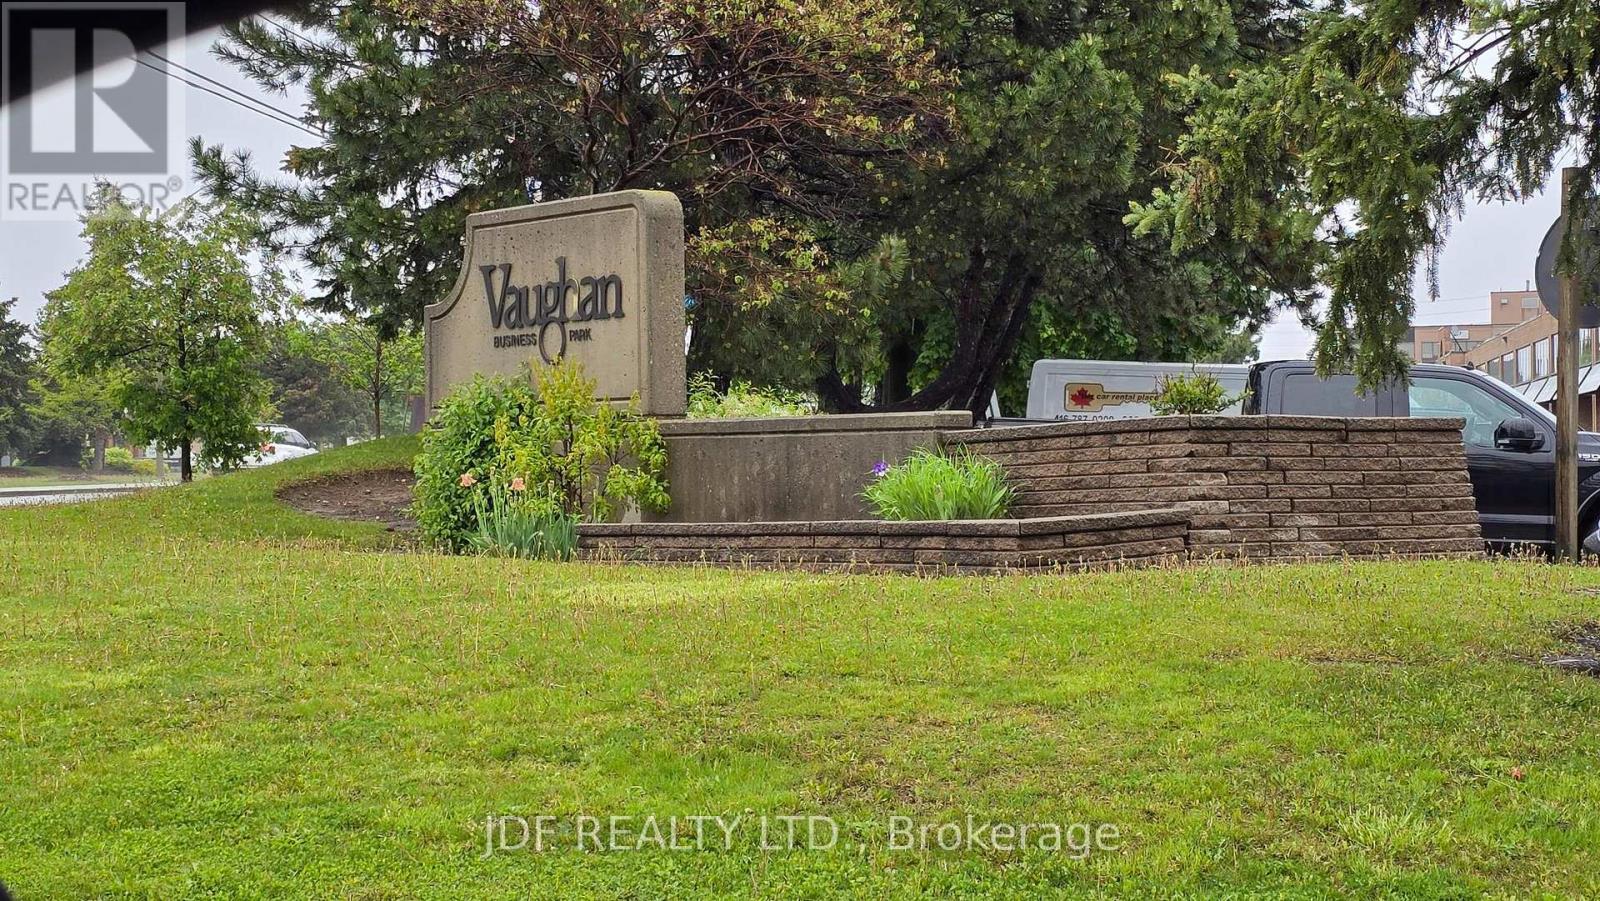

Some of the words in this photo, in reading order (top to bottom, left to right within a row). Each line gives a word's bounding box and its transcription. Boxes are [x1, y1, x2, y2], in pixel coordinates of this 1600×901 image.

[479, 255, 626, 366] Vaughan
[493, 333, 538, 349] BUSINESS
[568, 328, 593, 342] PARK
[1111, 392, 1136, 401] rental
